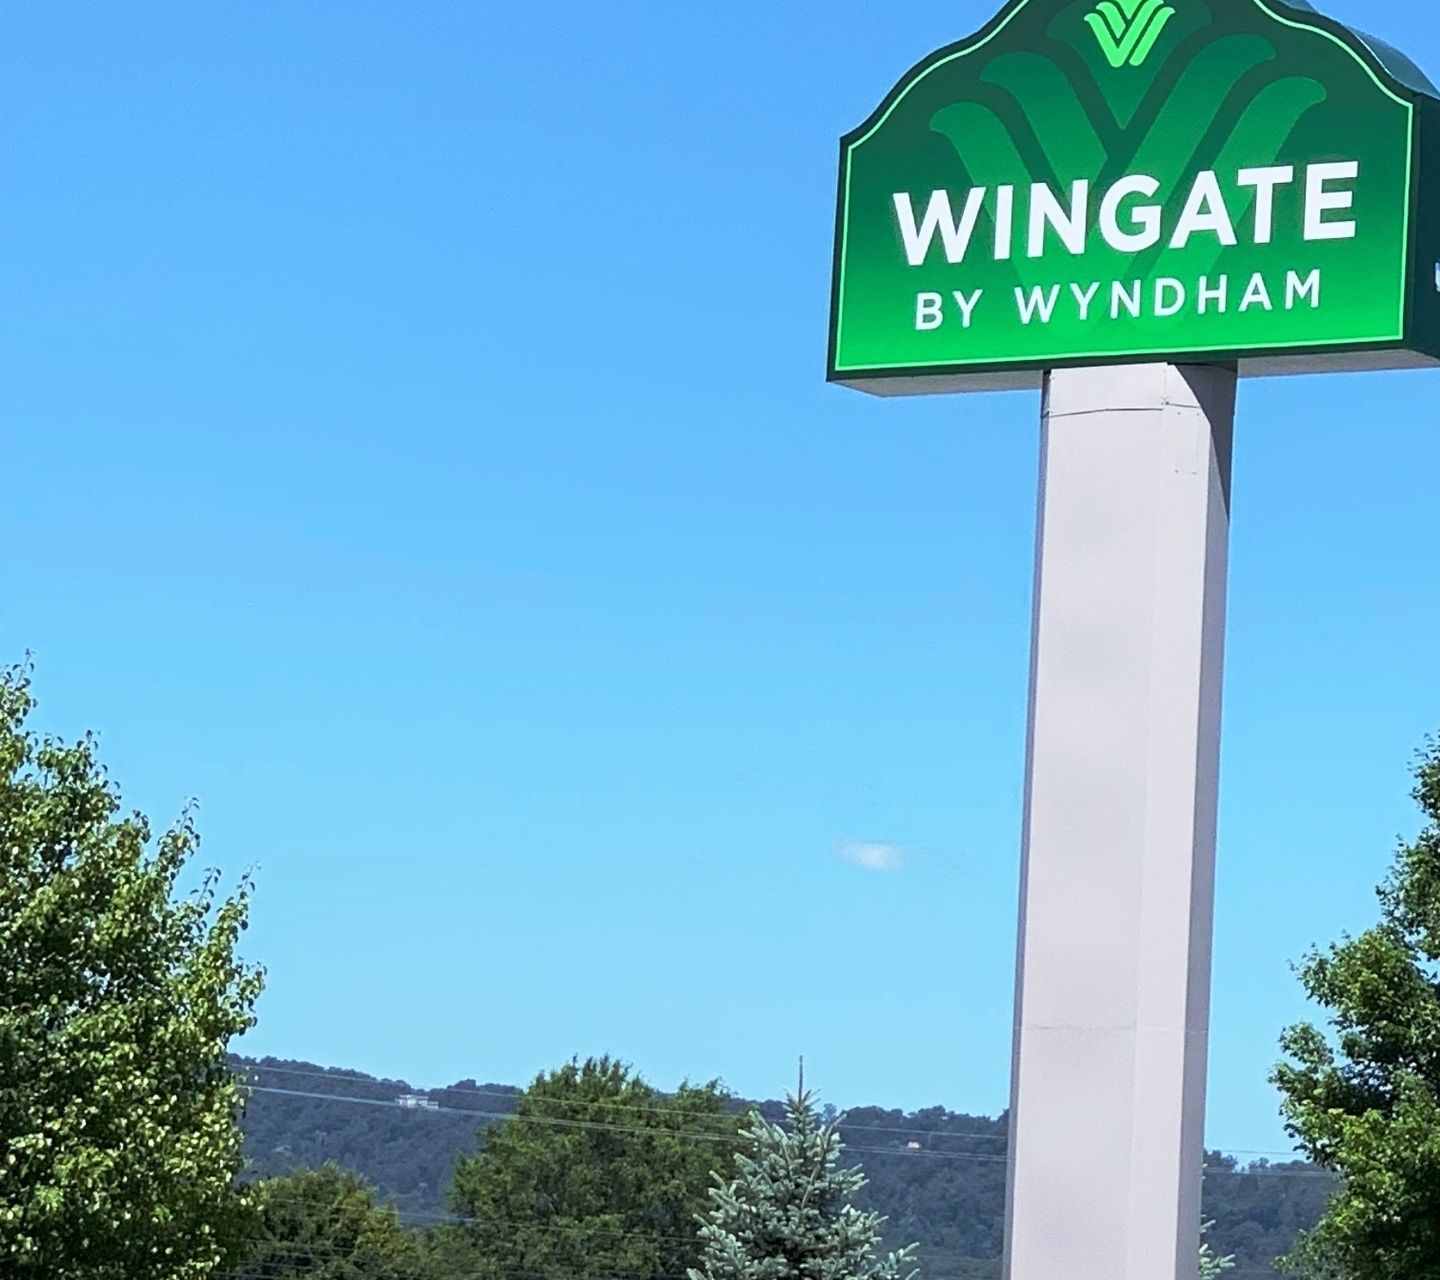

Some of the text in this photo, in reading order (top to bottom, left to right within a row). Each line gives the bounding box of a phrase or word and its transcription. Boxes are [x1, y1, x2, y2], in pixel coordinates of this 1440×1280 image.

[893, 160, 1358, 266] WINGATE
[915, 269, 1320, 330] BY WYNDHAM
